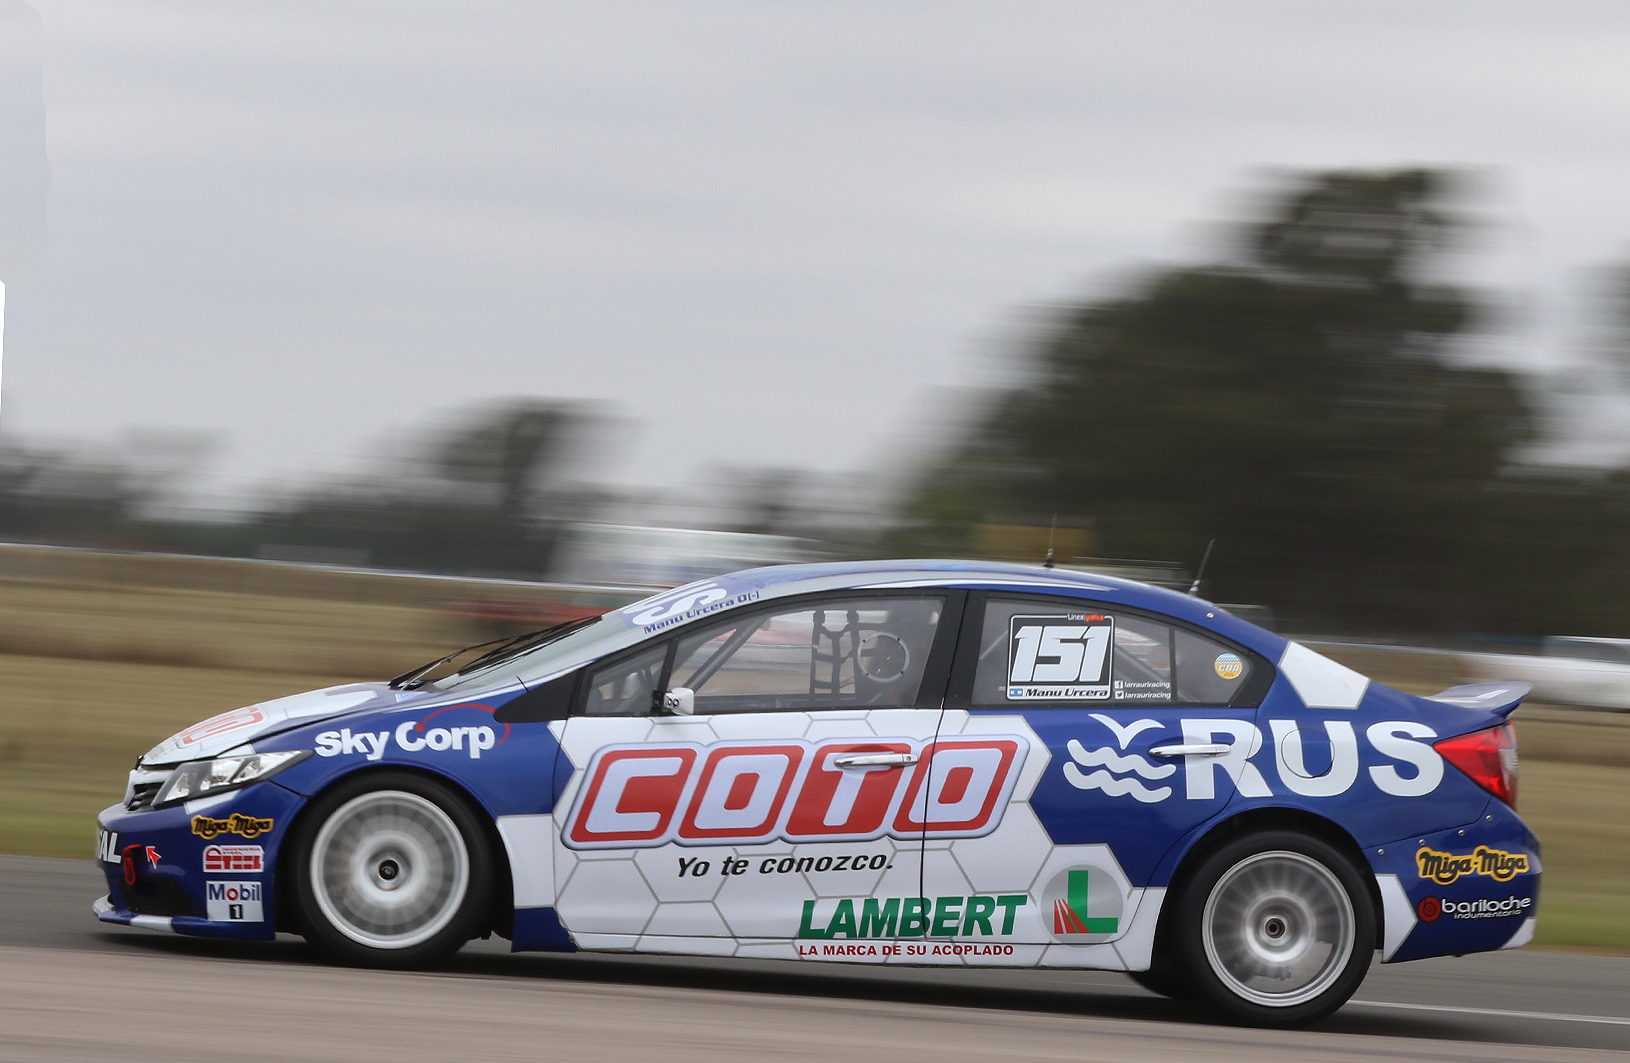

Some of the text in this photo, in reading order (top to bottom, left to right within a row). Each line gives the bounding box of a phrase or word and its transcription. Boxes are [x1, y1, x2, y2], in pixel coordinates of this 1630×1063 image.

[644, 616, 684, 634] Manu
[686, 599, 735, 618] Urcera
[1010, 626, 1111, 682] 151
[1025, 688, 1108, 697] Manu Urcera
[314, 721, 496, 761] Sky Corp
[1180, 718, 1444, 800] RUS
[571, 741, 1018, 842] COTO
[678, 854, 893, 877] Yo te conozco.
[209, 883, 262, 901] Mobil
[232, 904, 241, 919] 1
[1441, 896, 1532, 913] bariloche
[1453, 910, 1523, 920] indumentaria
[798, 895, 1028, 939] LAMBERT
[799, 945, 1014, 956] LA MARCA DE SU ACOPLADO
